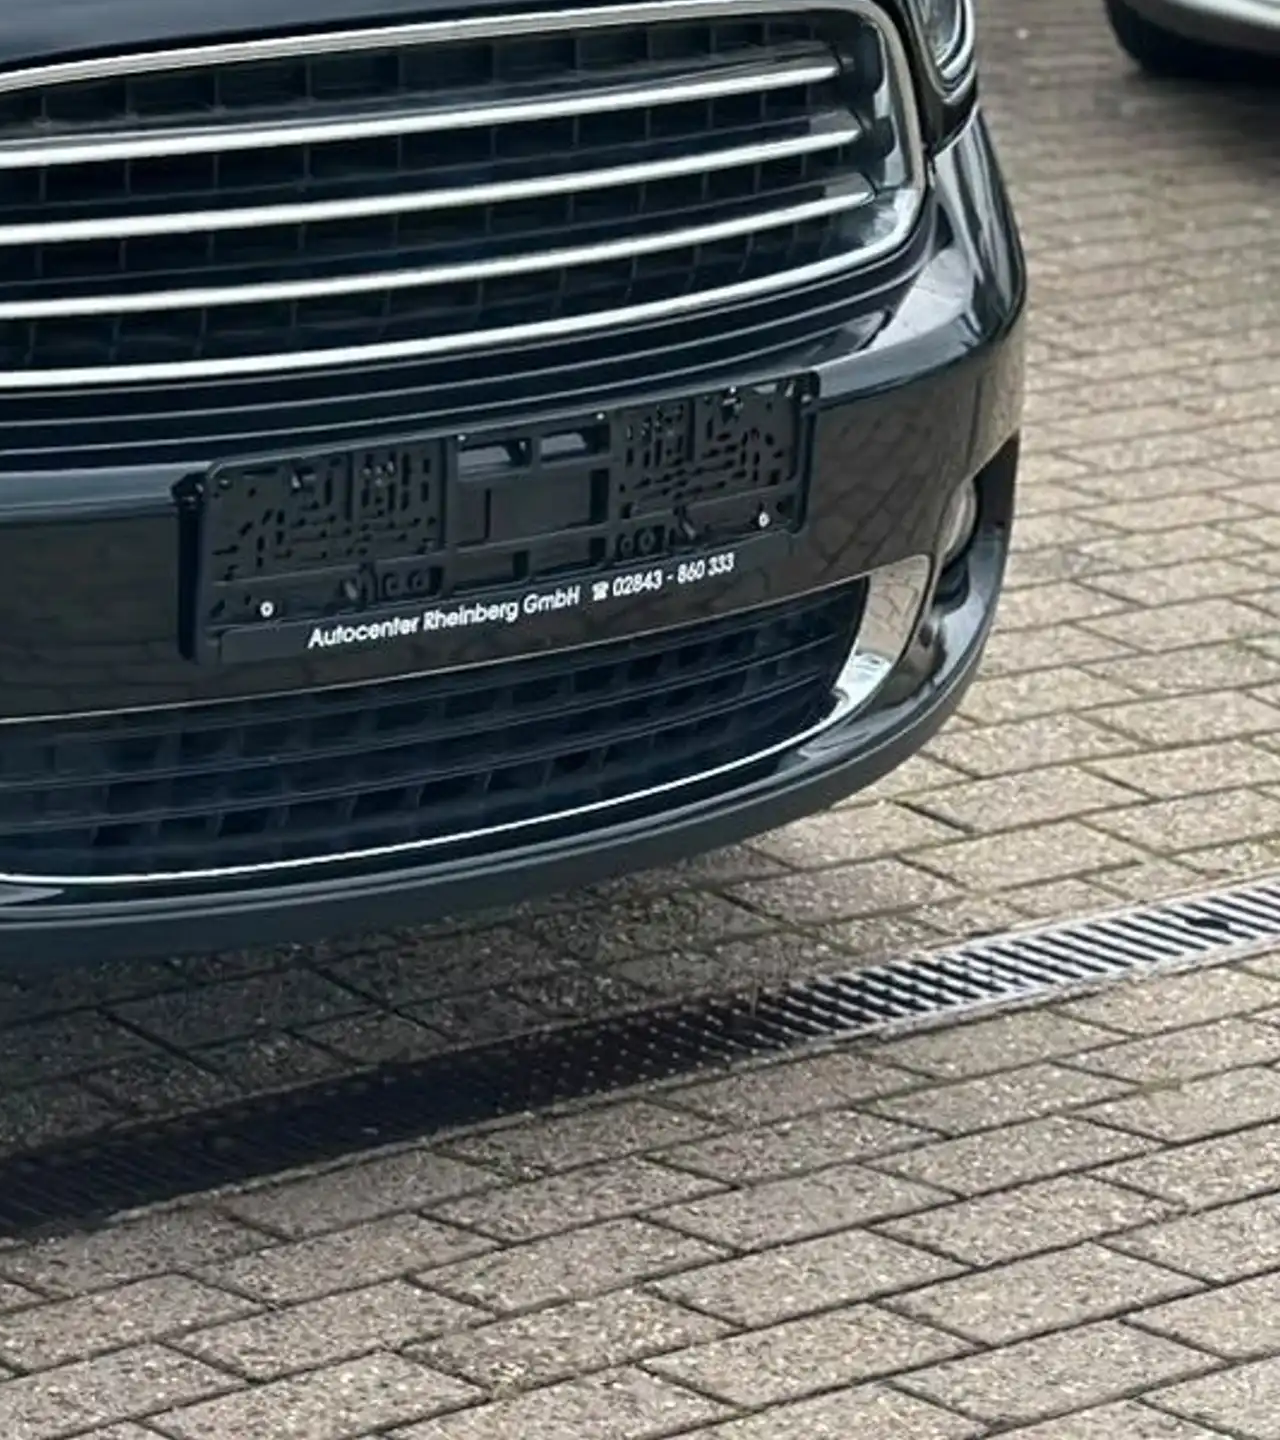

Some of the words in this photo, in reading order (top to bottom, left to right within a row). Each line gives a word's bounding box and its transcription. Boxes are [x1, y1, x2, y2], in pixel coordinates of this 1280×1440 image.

[307, 616, 421, 649] Autocenter
[423, 601, 519, 631] Rheinberg
[523, 585, 581, 614] GmbH
[612, 569, 663, 597] 02843
[677, 559, 706, 585] 860
[707, 551, 735, 577] 333
